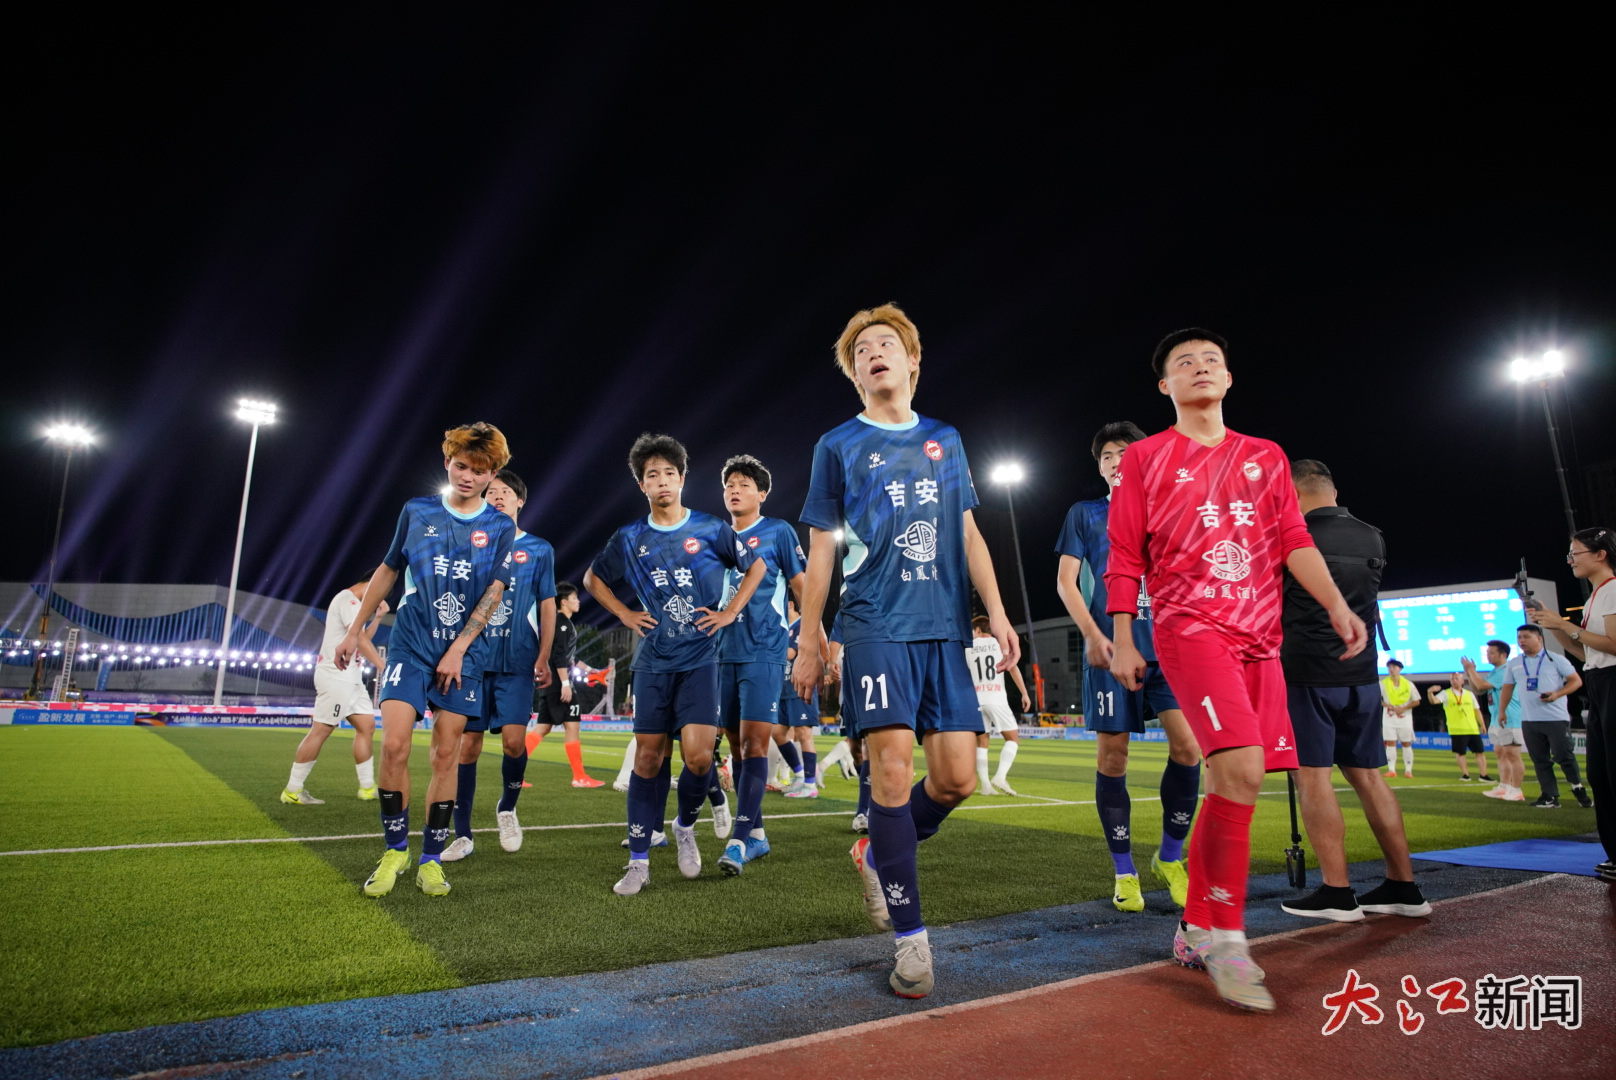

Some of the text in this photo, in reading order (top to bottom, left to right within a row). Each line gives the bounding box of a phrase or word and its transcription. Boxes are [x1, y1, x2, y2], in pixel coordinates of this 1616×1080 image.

[869, 460, 887, 469] KELME
[884, 478, 939, 508] 吉安
[1196, 500, 1256, 528] 吉安
[433, 554, 472, 581] 吉安
[650, 567, 693, 588] 吉安
[1485, 622, 1495, 635] 2
[974, 655, 996, 682] 18
[861, 673, 889, 711] 21
[333, 704, 341, 717] 9
[570, 704, 580, 716] 27
[1097, 691, 1114, 717] 31
[1201, 695, 1222, 731] 1
[38, 712, 86, 723] 盈新发展
[887, 897, 911, 905] KELME
